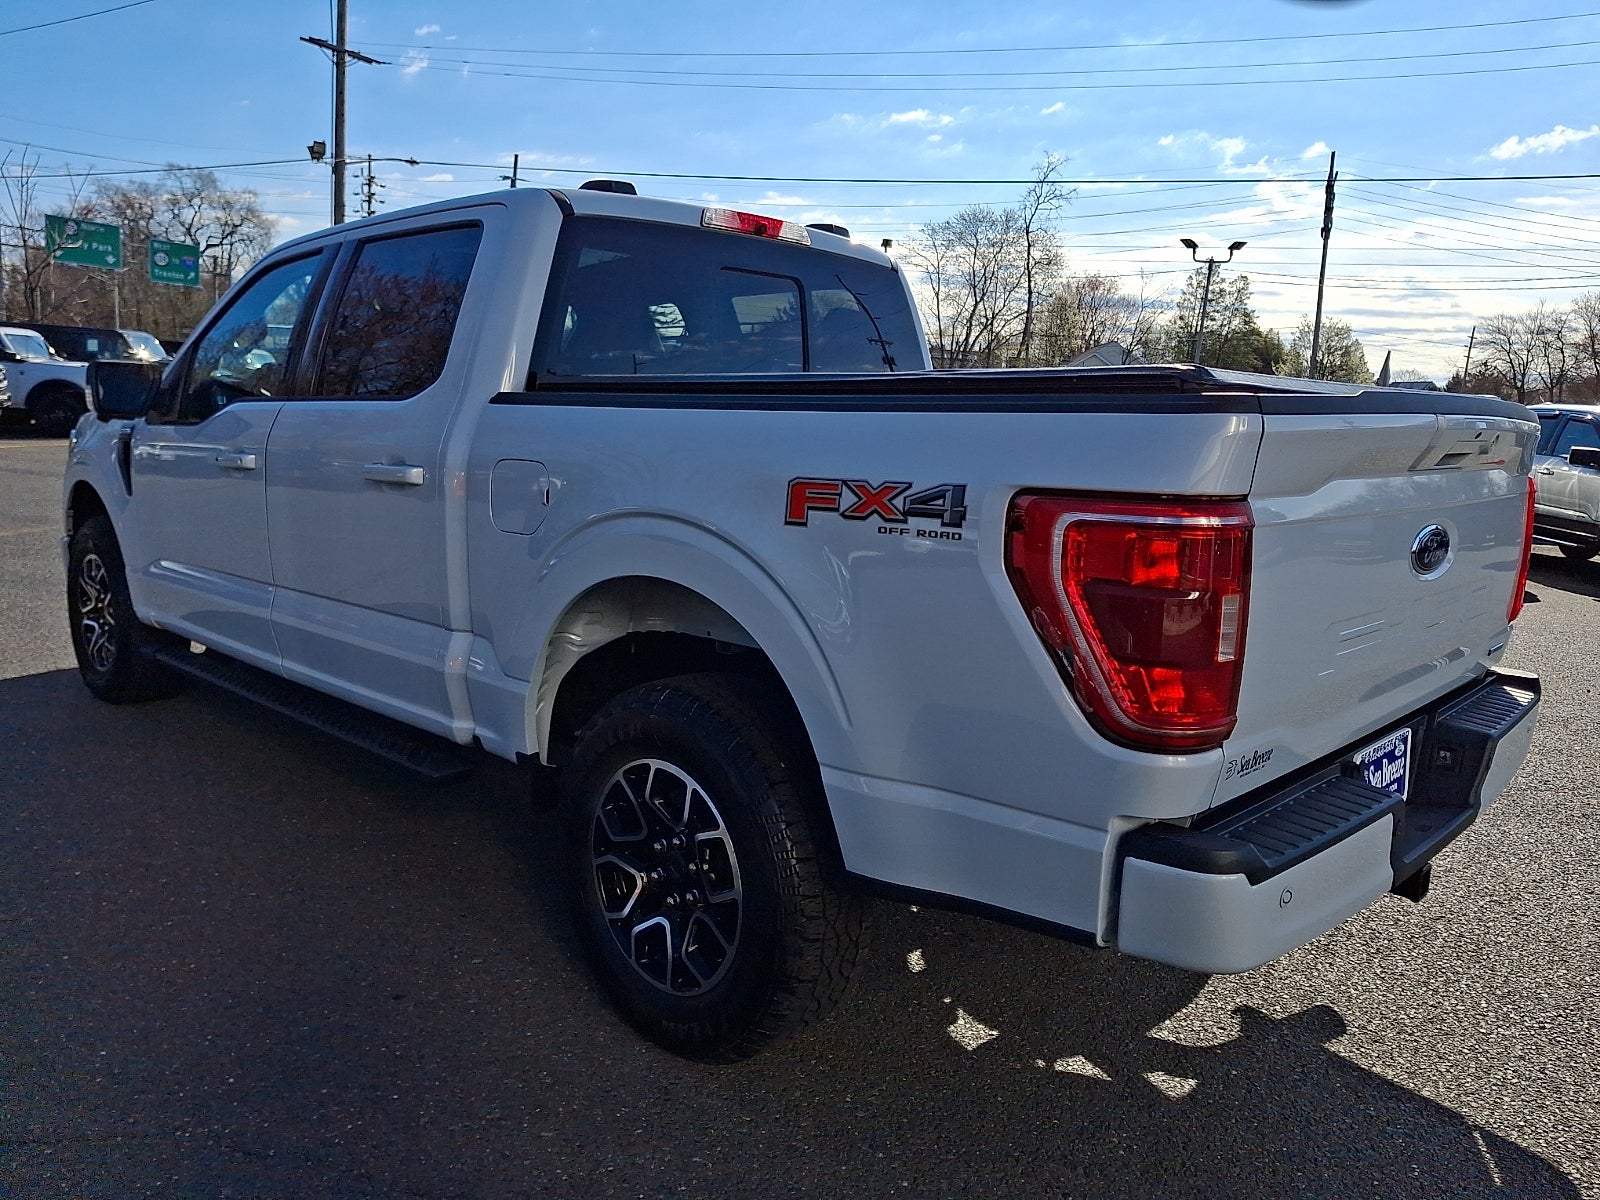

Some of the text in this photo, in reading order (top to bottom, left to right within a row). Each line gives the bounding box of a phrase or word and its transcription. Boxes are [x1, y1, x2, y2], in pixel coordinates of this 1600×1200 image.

[784, 476, 967, 528] FX4
[877, 526, 962, 541] OFF ROAD
[1237, 755, 1251, 775] Sea
[1250, 750, 1273, 769] Breeze
[1369, 765, 1381, 788] Sea
[1382, 758, 1405, 787] Breeze
